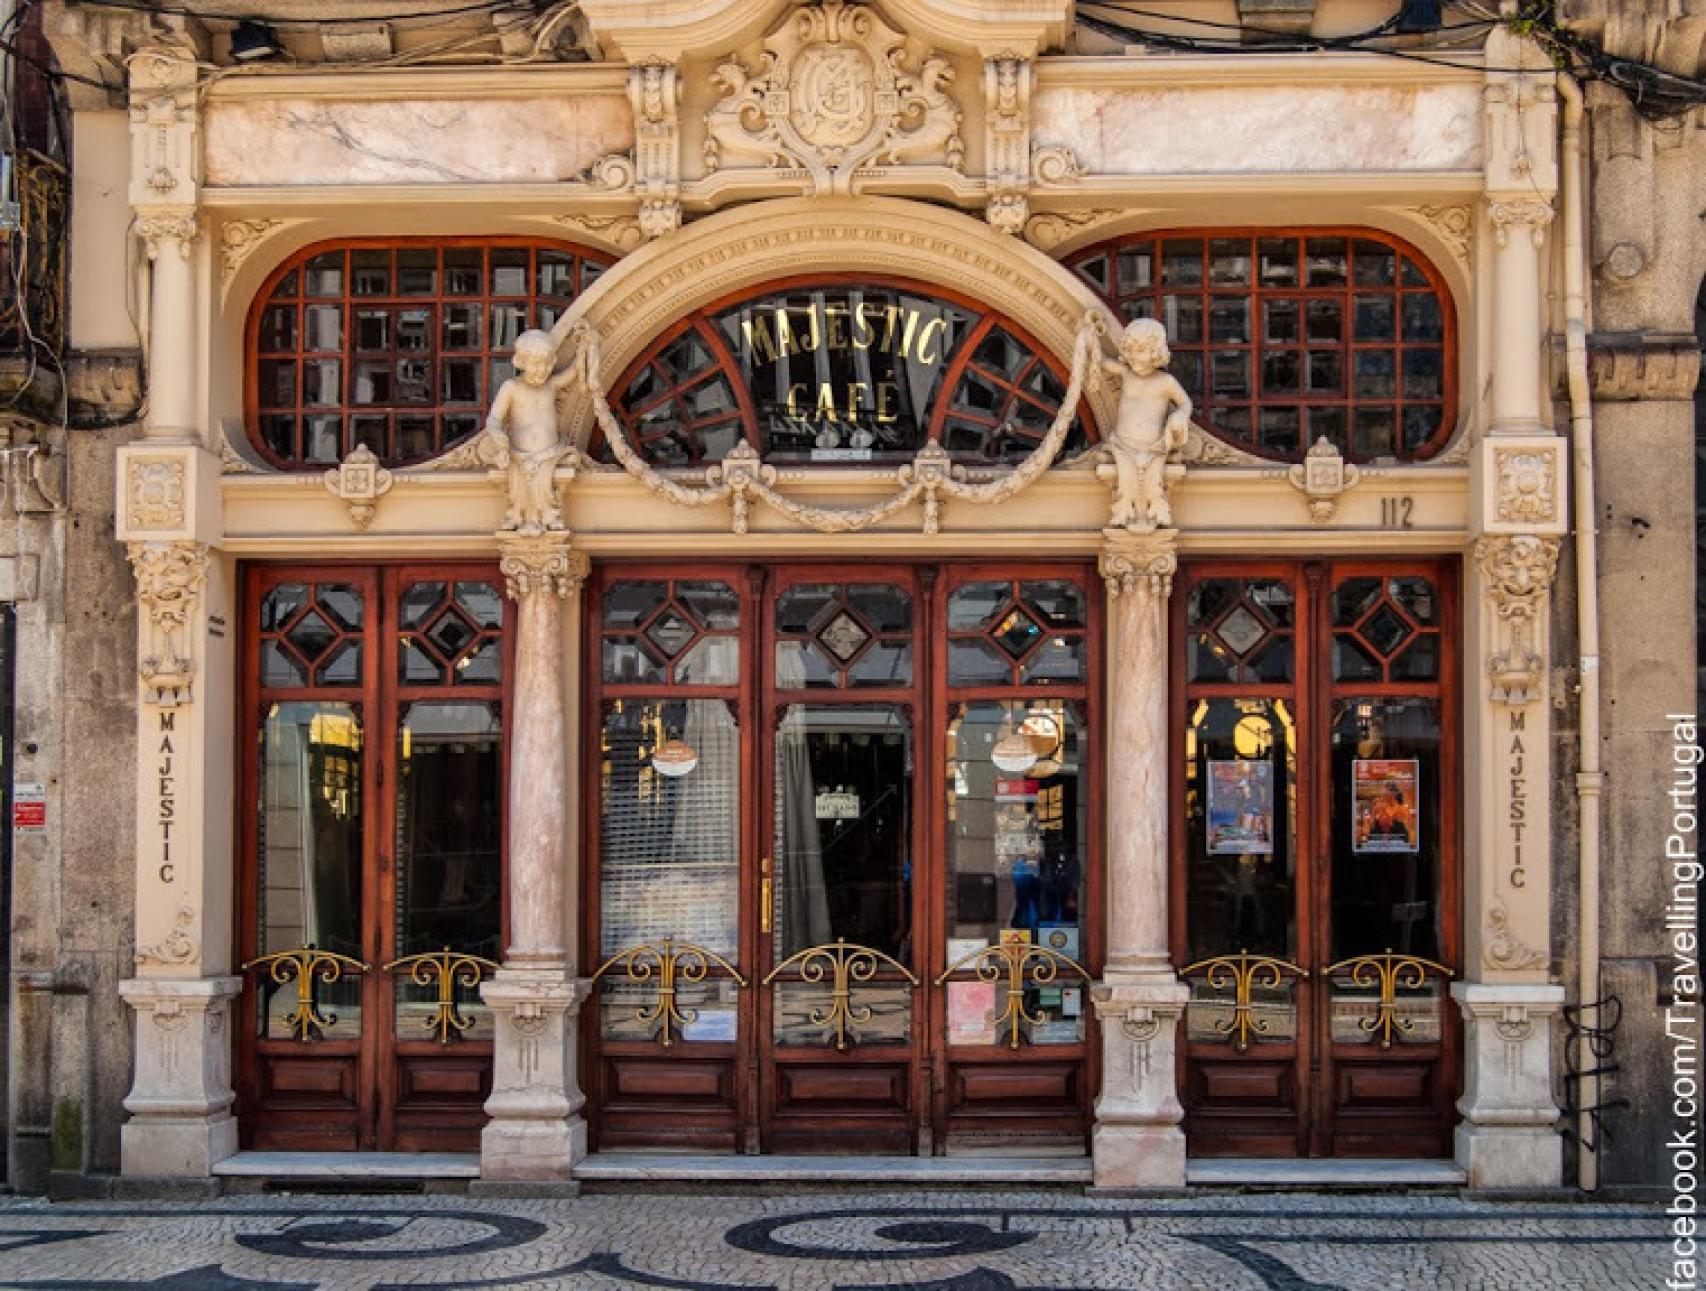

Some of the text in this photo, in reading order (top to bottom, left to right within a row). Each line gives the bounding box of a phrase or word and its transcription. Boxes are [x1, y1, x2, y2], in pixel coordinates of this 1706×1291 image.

[742, 301, 947, 367] MAJESTIC
[1381, 496, 1413, 528] 112
[158, 712, 175, 884] MAJESTIC
[1509, 711, 1526, 888] MAJESTIC
